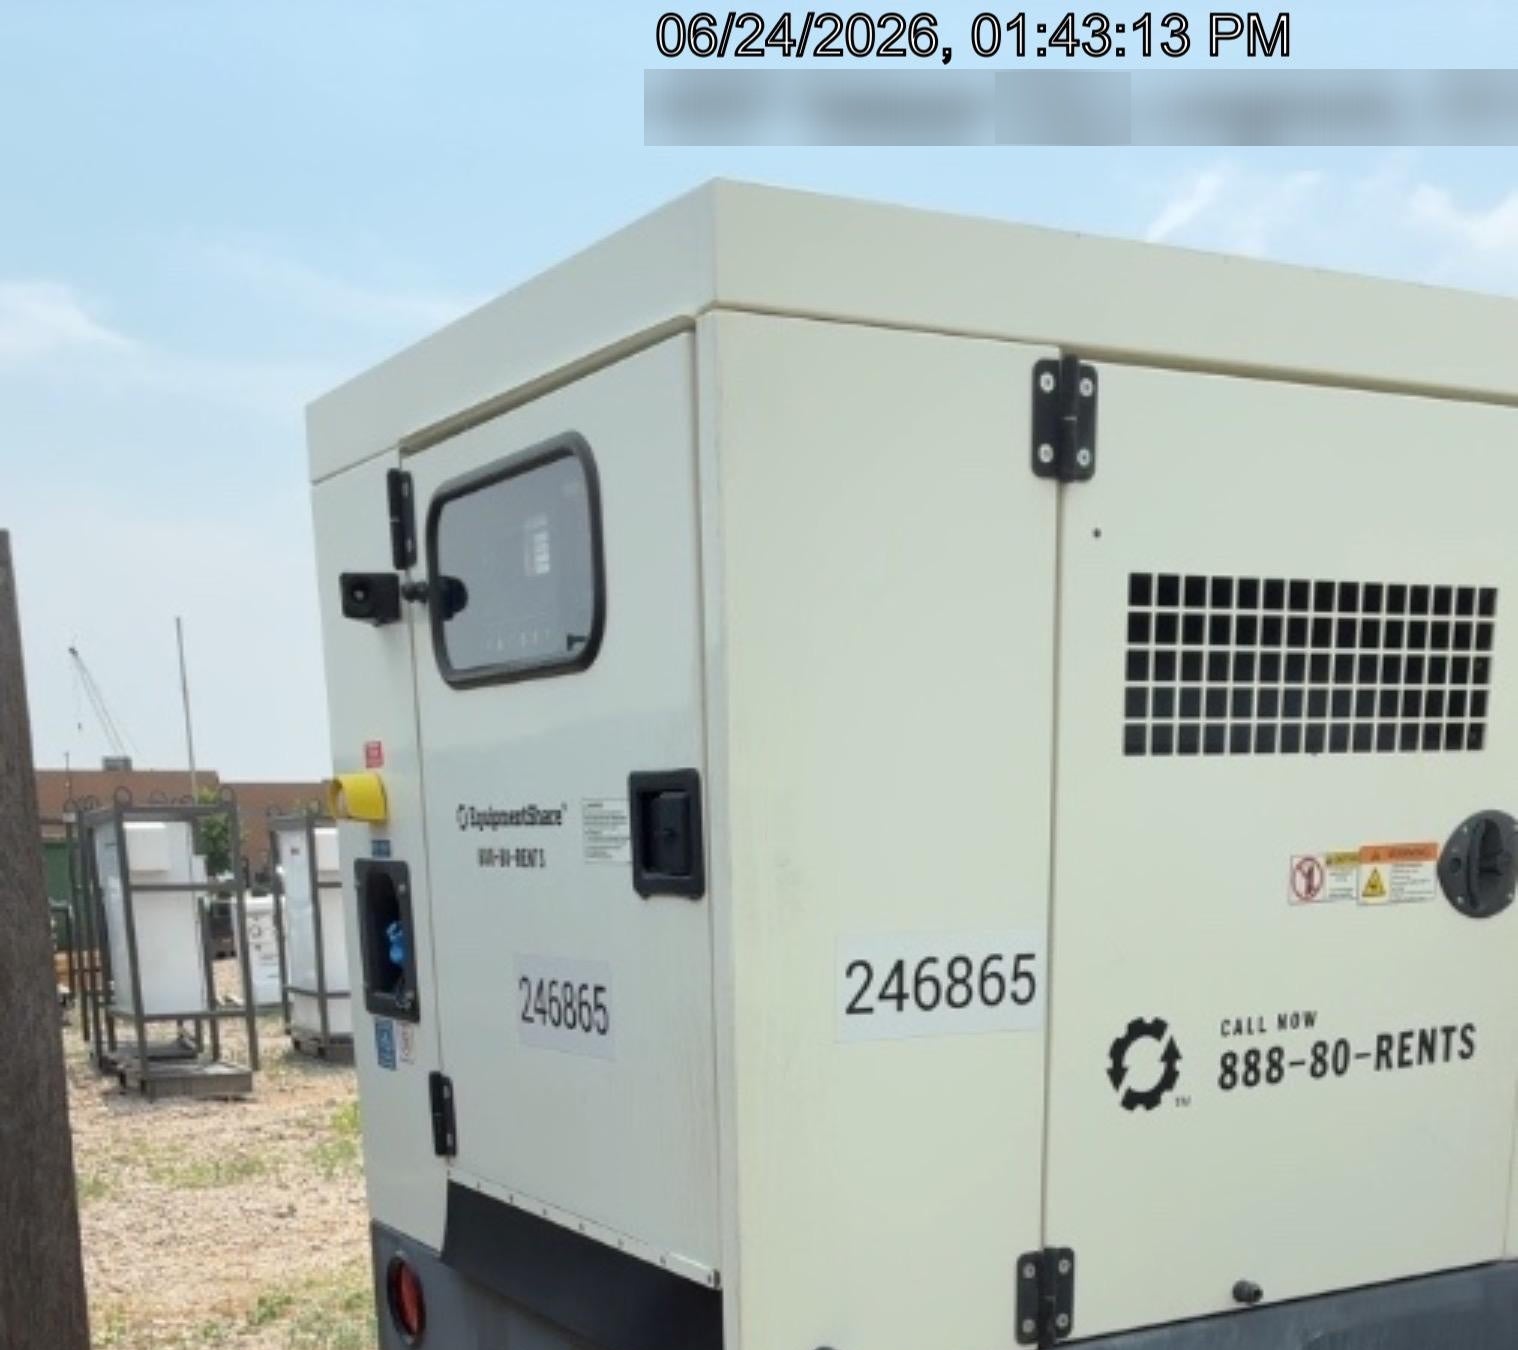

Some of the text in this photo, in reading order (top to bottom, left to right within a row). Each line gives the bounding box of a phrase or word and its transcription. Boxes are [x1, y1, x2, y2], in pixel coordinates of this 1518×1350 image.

[518, 974, 610, 1036] 246865
[845, 953, 1036, 1015] 246865
[1220, 1010, 1318, 1037] CALL NOW
[1218, 1022, 1477, 1091] 888-80-RENTS
